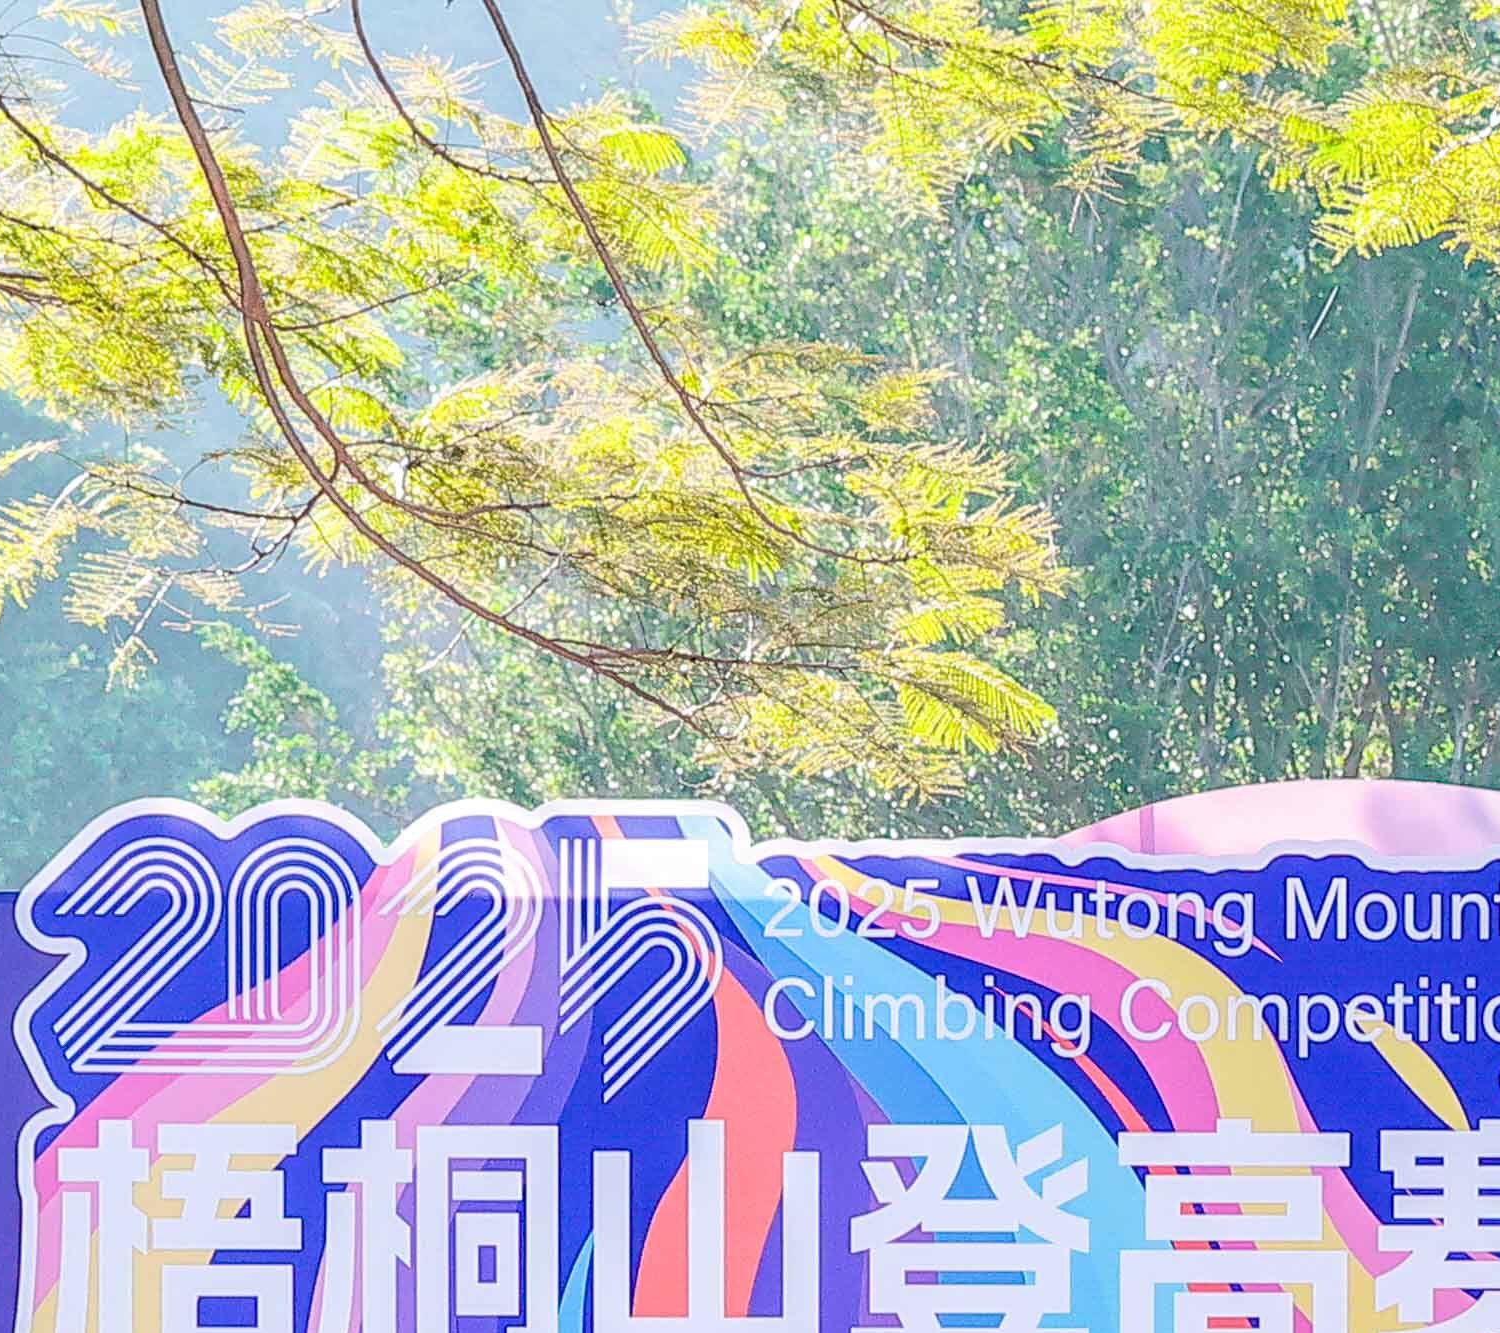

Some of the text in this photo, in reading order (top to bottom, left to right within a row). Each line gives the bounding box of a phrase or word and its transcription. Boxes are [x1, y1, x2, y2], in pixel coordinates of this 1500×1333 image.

[763, 875, 941, 940] 2025
[965, 873, 1255, 956] Wutong
[53, 836, 722, 1104] 2025
[765, 978, 1090, 1060] Climbing
